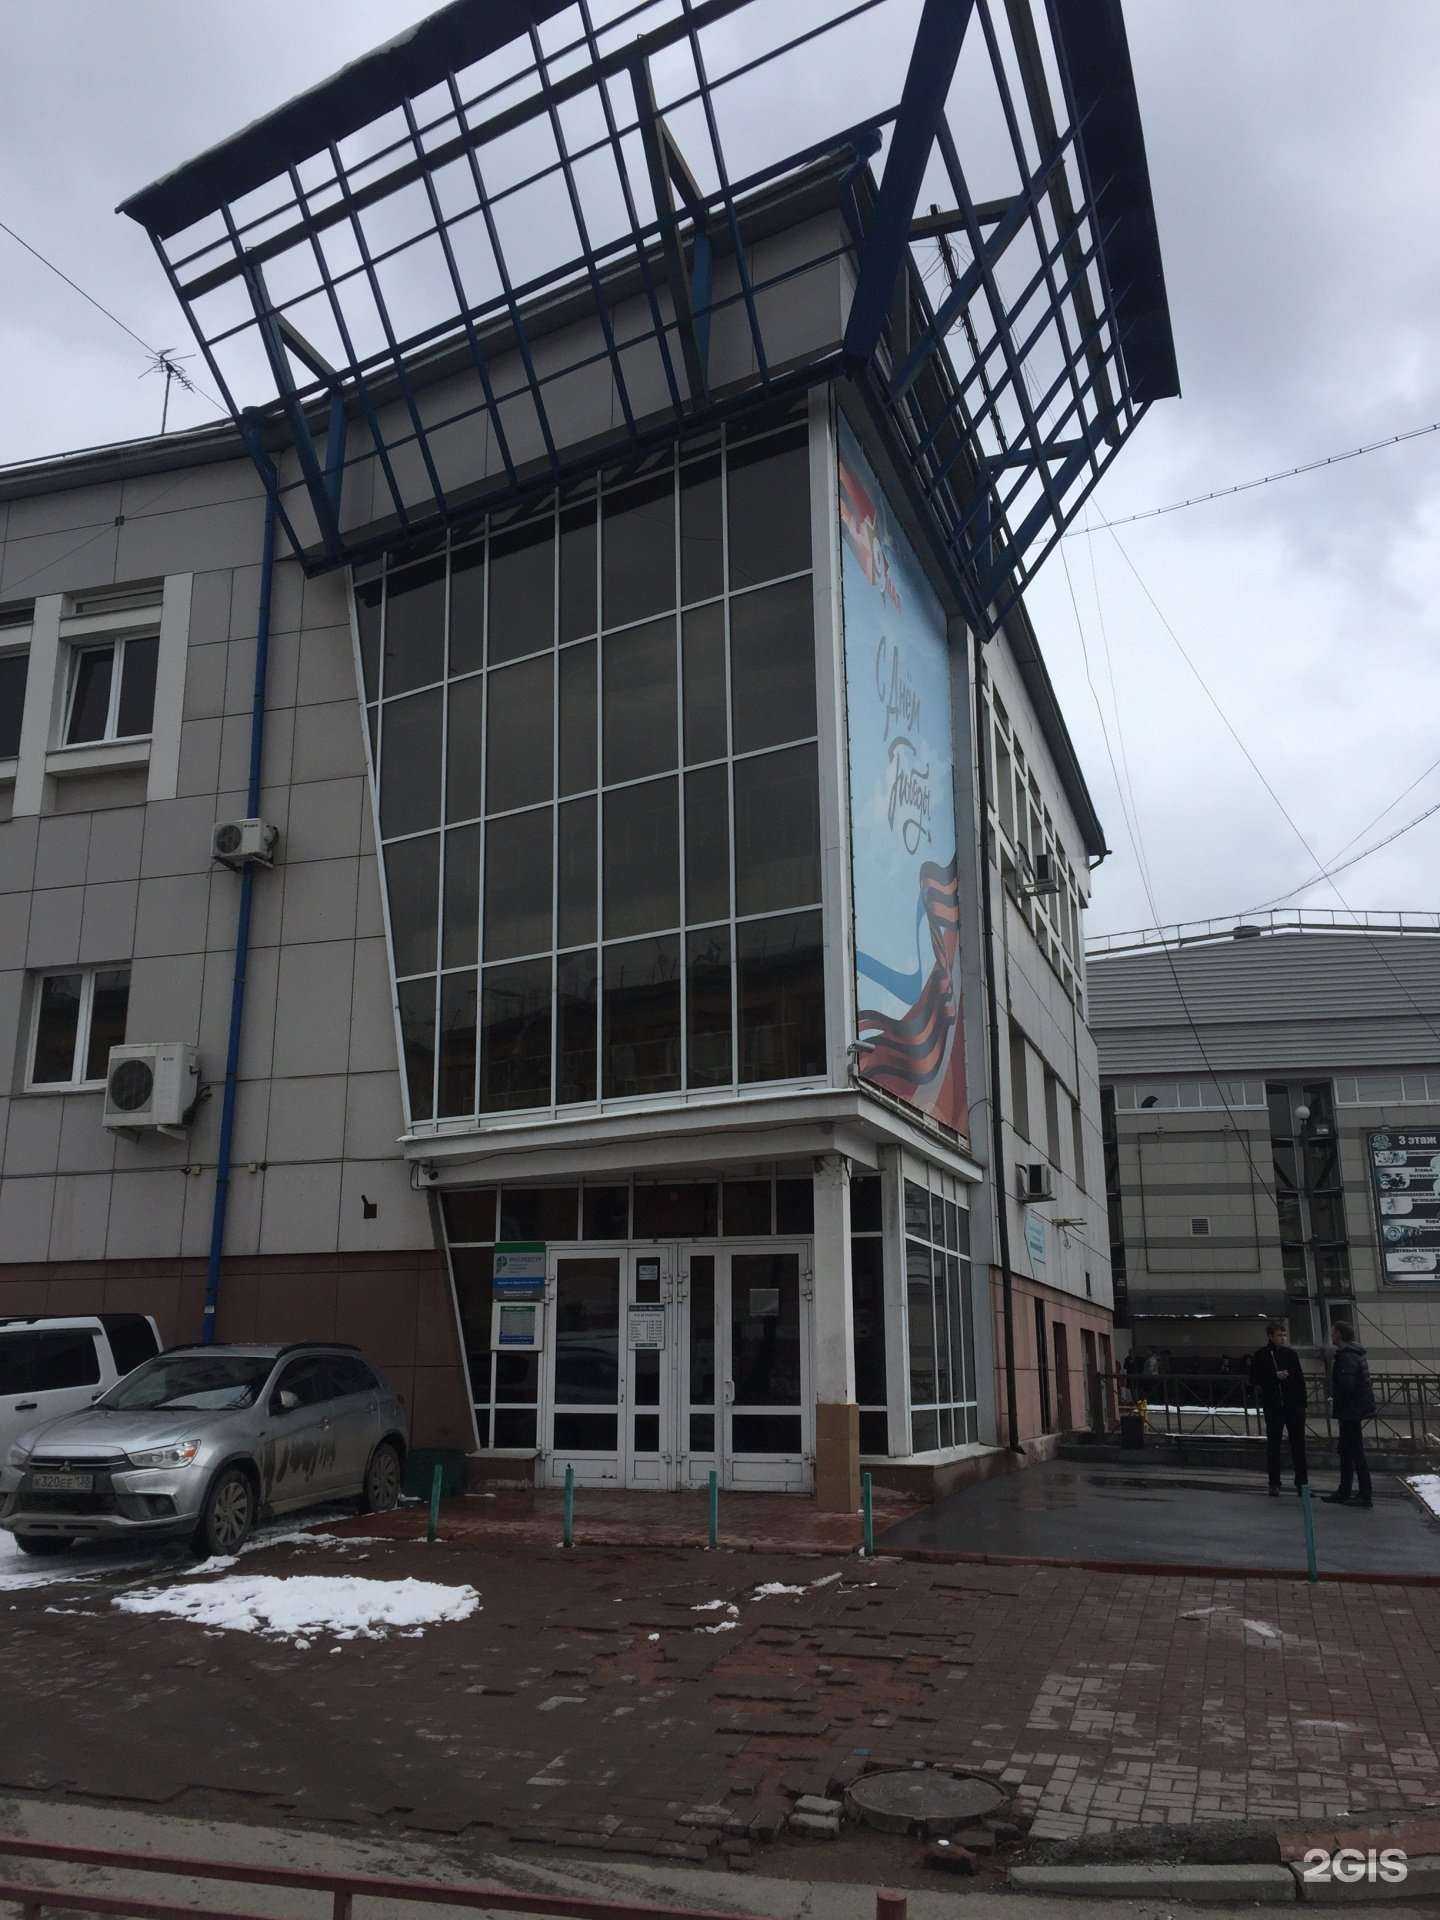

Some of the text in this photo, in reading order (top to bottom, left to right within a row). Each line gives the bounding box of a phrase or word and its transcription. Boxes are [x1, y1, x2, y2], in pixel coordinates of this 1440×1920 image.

[876, 636, 886, 703] С
[1398, 1135, 1437, 1145] 3 этаж
